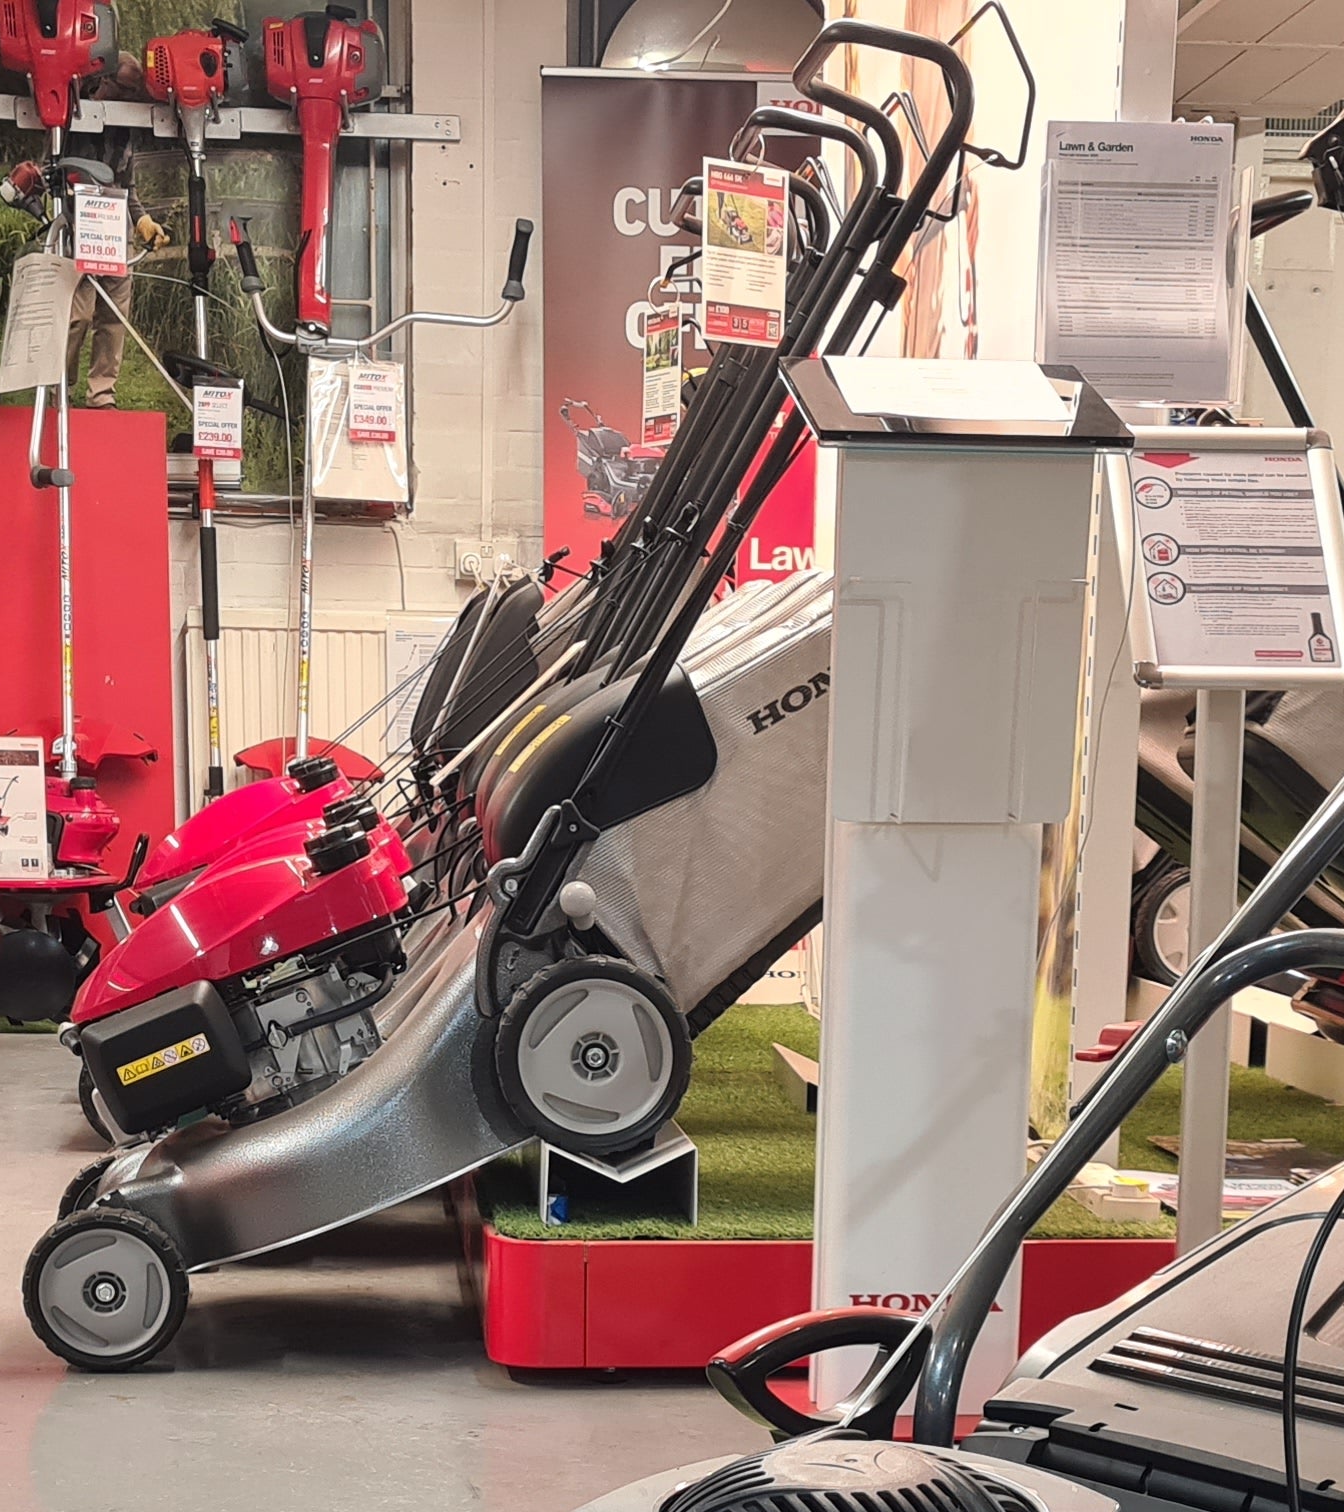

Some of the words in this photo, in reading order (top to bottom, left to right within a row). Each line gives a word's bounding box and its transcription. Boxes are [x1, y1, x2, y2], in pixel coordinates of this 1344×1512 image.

[1190, 135, 1224, 143] HONDA
[1059, 141, 1086, 151] Lawn
[1088, 142, 1095, 151] &
[1098, 142, 1134, 153] Garden
[85, 200, 117, 211] MITOX
[80, 244, 116, 256] £319.00
